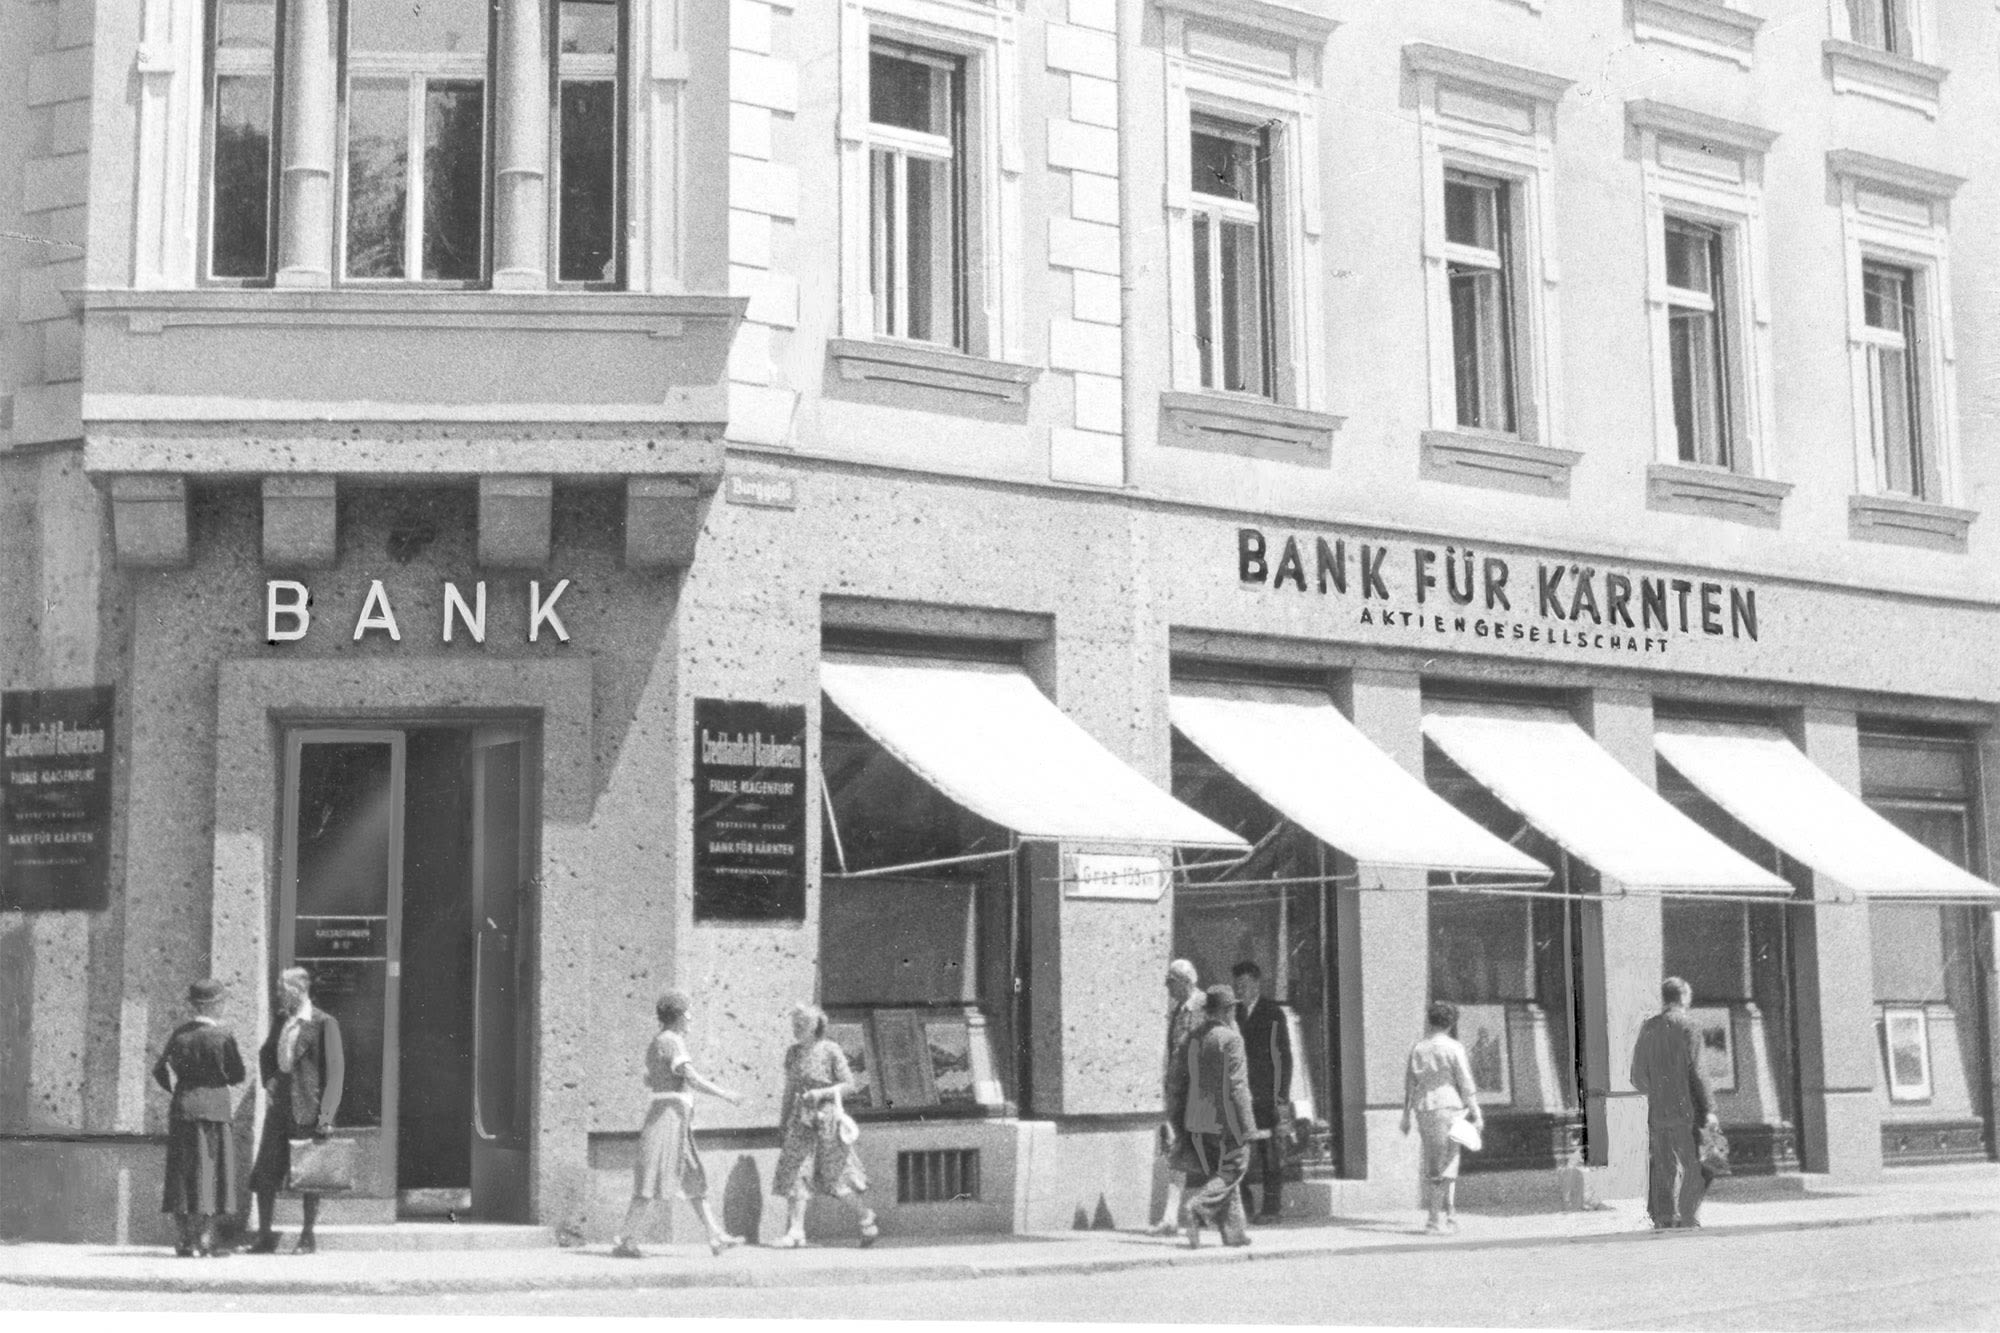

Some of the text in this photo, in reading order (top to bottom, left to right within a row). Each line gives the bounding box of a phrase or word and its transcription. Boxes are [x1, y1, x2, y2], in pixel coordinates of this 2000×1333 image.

[267, 579, 570, 643] BANK
[1238, 527, 1758, 642] BANK FÜR KÄRNTEN
[1360, 607, 1669, 653] AKTIENGESELLSCHAFT
